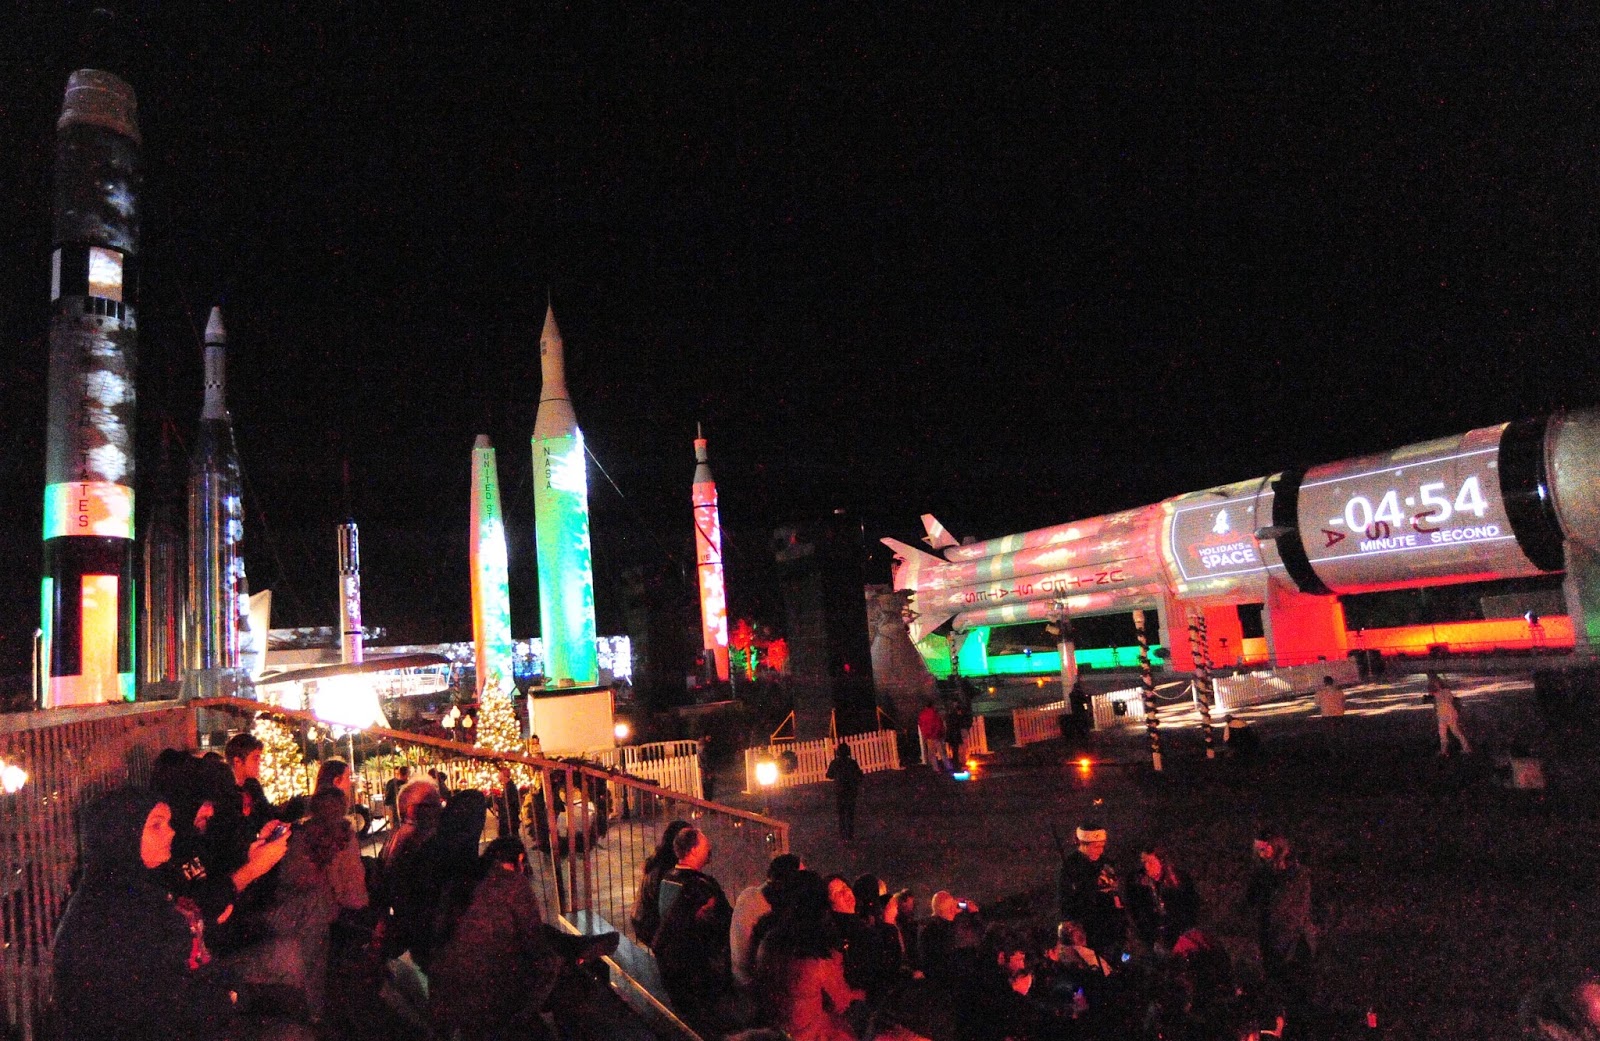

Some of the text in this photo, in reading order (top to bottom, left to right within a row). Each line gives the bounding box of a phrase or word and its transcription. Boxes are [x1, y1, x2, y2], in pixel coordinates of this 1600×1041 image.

[78, 438, 90, 528] STATES
[482, 453, 492, 500] UNITED
[543, 447, 552, 490] NASA
[1328, 475, 1489, 533] -04:54
[1198, 542, 1245, 557] HOLIDAYS
[1359, 524, 1499, 552] MINUTE SECOND
[1201, 548, 1256, 569] SPACE
[965, 569, 1124, 604] UNITED STATES
